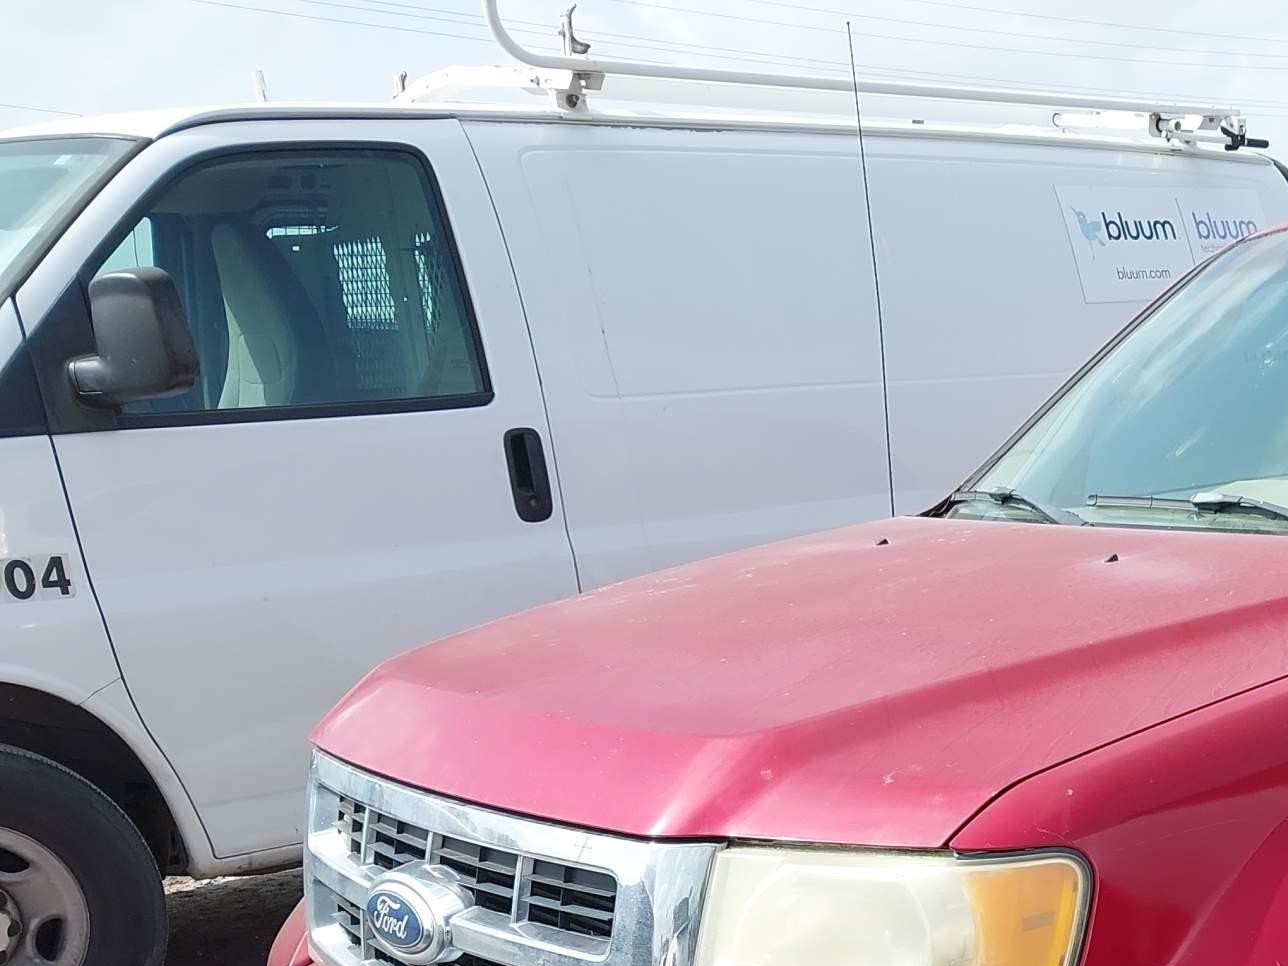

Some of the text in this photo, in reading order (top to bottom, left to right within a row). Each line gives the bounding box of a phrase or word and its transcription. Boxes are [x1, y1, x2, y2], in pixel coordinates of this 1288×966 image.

[1101, 211, 1177, 241] bluum
[1191, 211, 1258, 241] bluum
[1115, 267, 1172, 281] bluum.com
[3, 556, 72, 600] 04
[373, 895, 409, 939] Ford
